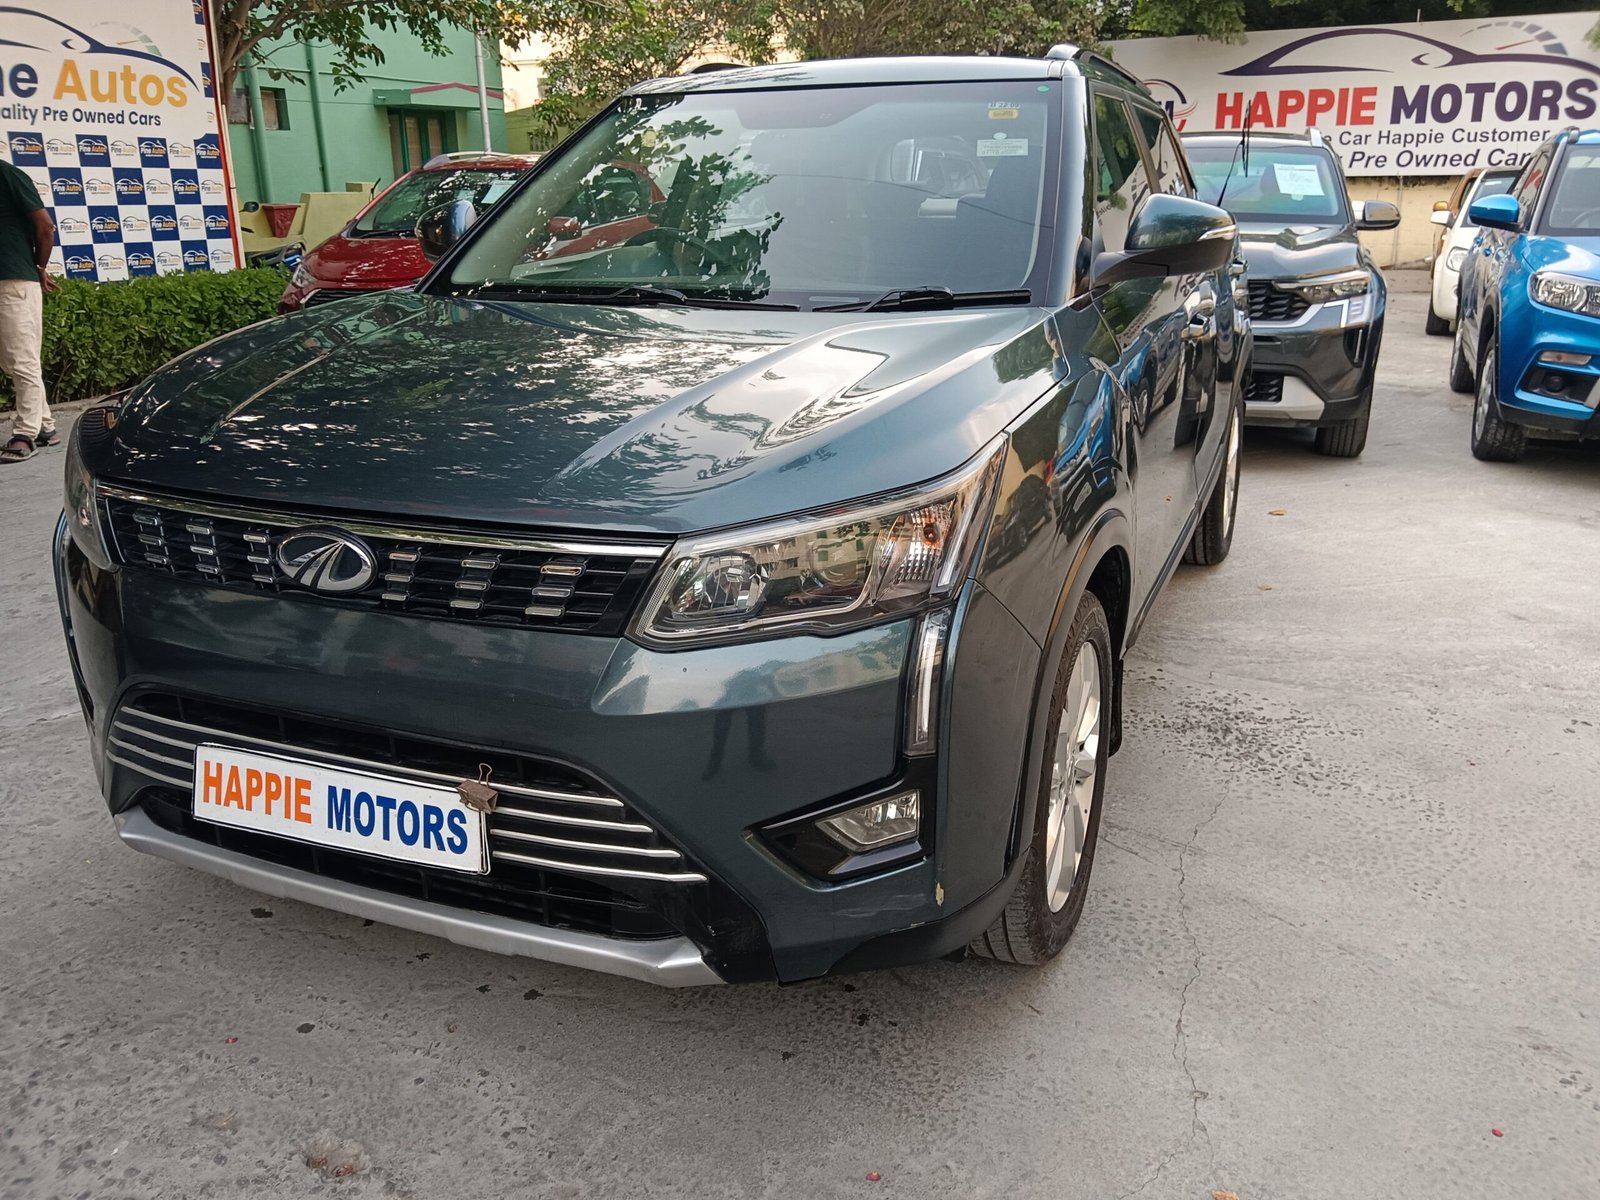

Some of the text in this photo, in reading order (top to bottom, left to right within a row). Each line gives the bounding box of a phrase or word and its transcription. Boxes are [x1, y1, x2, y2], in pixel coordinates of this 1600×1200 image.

[53, 58, 188, 108] Autos
[42, 106, 69, 122] Pre
[72, 107, 125, 125] Owned
[128, 111, 161, 126] Cars
[1215, 86, 1378, 130] HAPPIE
[1390, 78, 1598, 125] MOTORS
[1338, 130, 1372, 146] Car
[1377, 129, 1444, 147] Happie
[1451, 127, 1551, 143] Customer
[1348, 151, 1388, 168] Pre
[1396, 148, 1480, 168] Owned
[203, 760, 468, 855] HAPPIE MOTORS
